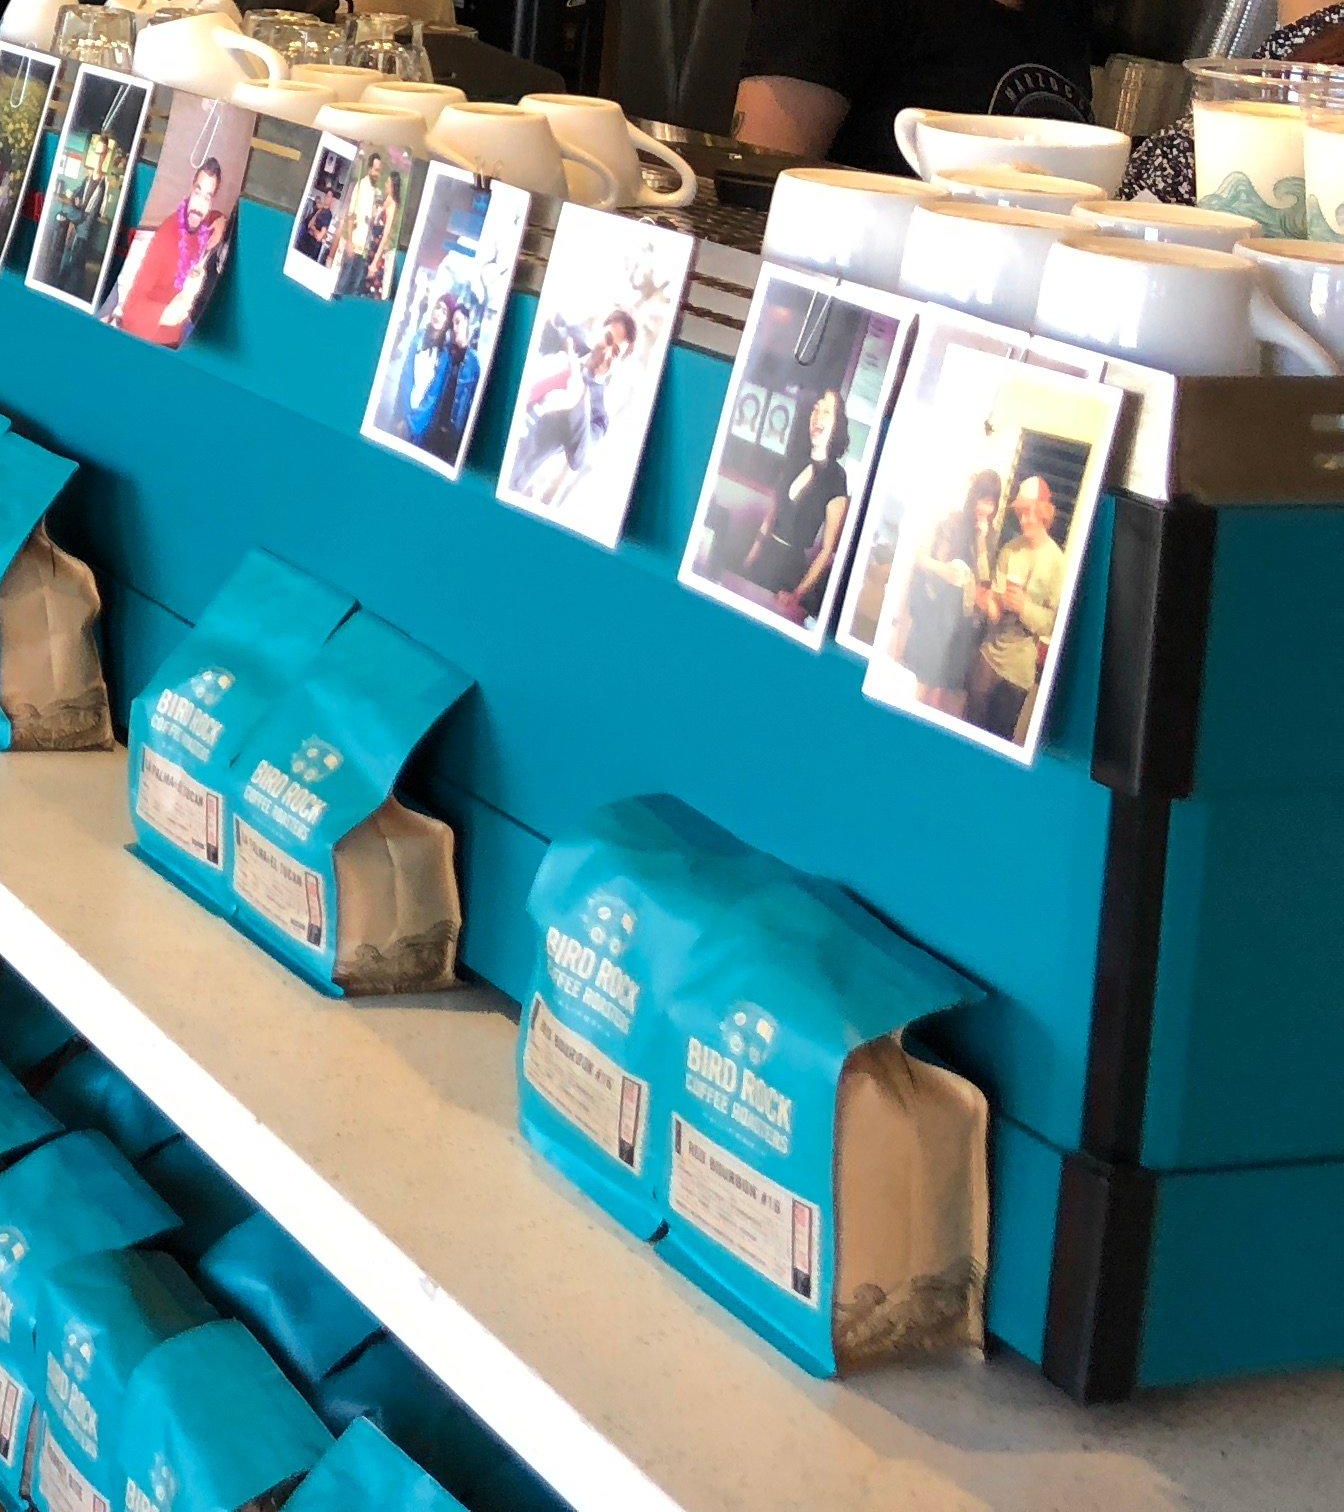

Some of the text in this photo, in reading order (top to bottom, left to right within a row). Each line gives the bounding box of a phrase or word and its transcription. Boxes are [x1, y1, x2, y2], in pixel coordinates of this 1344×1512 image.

[546, 926, 597, 980] BIRD
[687, 1037, 793, 1133] BIRD ROCK
